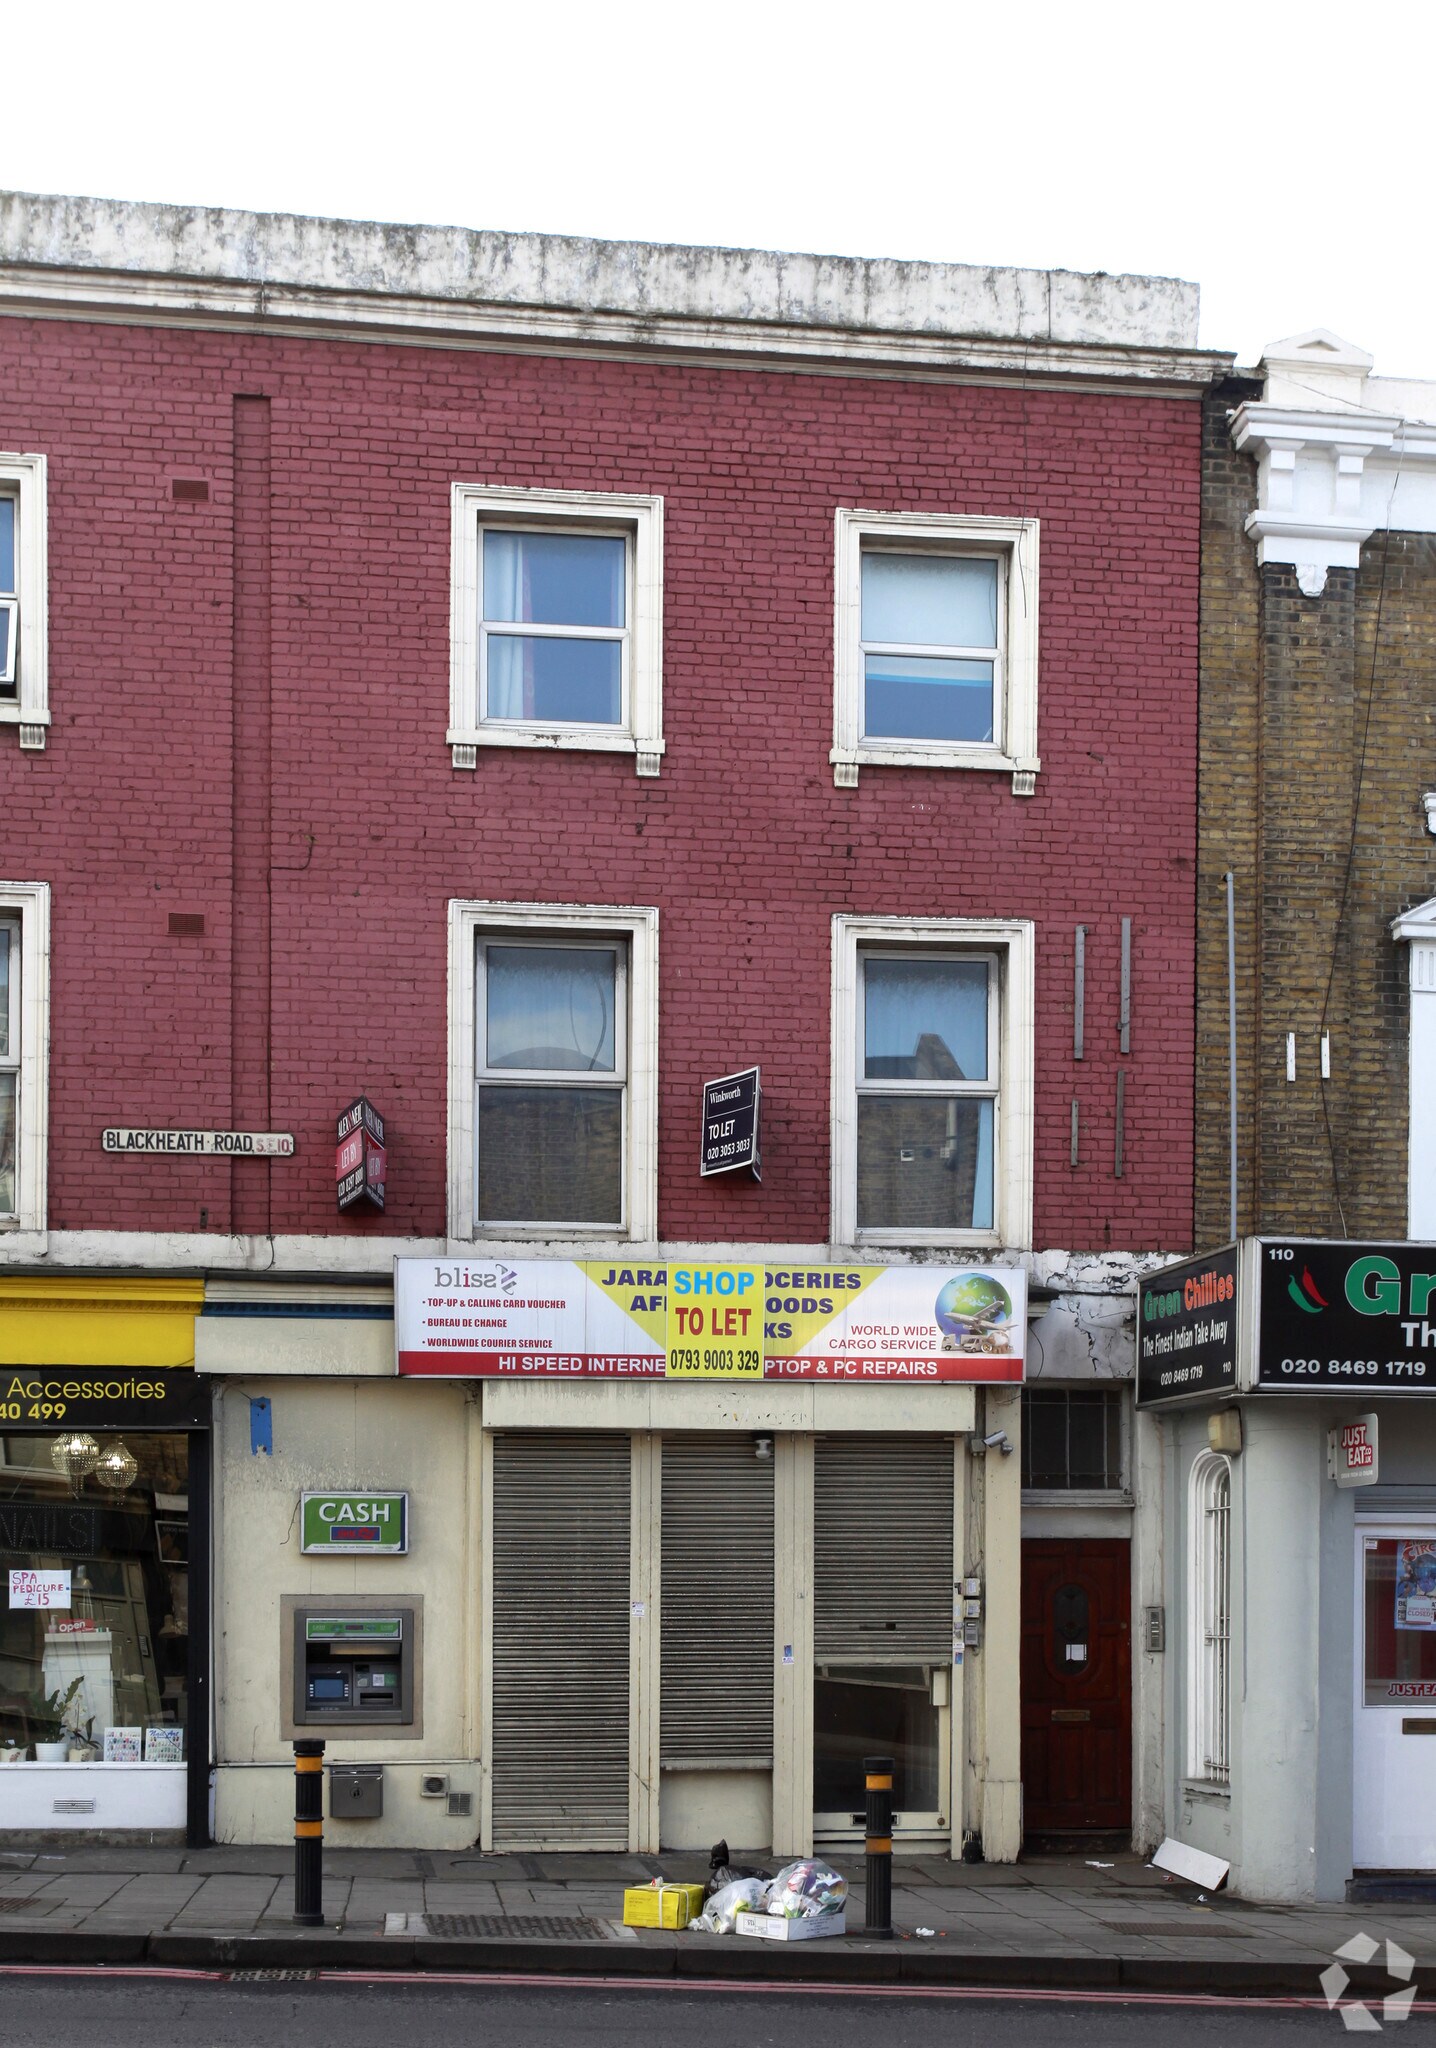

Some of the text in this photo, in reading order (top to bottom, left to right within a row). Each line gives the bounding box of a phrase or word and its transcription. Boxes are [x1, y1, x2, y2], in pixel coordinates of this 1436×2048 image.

[710, 1086, 741, 1104] Winkworth
[708, 1119, 735, 1140] TO LET
[106, 1131, 204, 1150] BLACKHEATH
[707, 1138, 750, 1160] 020 3053 3033
[341, 1147, 350, 1169] LET
[1269, 1249, 1294, 1261] 110
[674, 1270, 755, 1295] SHOP
[427, 1298, 458, 1307] TOP-UP
[468, 1298, 501, 1308] CALLING
[503, 1299, 525, 1308] CARD
[527, 1299, 566, 1309] VOUCHER
[630, 1295, 667, 1312] AF
[1144, 1271, 1234, 1322] Green Chillies
[427, 1318, 507, 1328] BUREAU DE CHANGE
[675, 1307, 752, 1336] TO LET
[851, 1325, 937, 1336] WORLD WIDE
[427, 1338, 553, 1348] WORLDWIDE COURIER SERVICE
[829, 1338, 937, 1350] CARGO SERVICE
[1143, 1319, 1228, 1357] The Finest Indian Take Away
[498, 1356, 516, 1370] HI
[522, 1356, 583, 1371] SPEED
[816, 1360, 828, 1374] &
[833, 1361, 857, 1374] PC
[862, 1361, 938, 1375] REPAIRS
[670, 1348, 759, 1371] 0793 9003 329
[1281, 1358, 1426, 1376] 020 8469 1719
[1161, 1361, 1231, 1386] 020 8469 1719 110
[6, 1377, 166, 1399] Accessories
[28, 1403, 66, 1419] 499
[1342, 1426, 1366, 1447] JUST
[1348, 1446, 1366, 1466] EAT
[319, 1502, 390, 1522] CASH
[0, 1512, 88, 1548] NAILS
[12, 1571, 38, 1585] SPA
[13, 1583, 64, 1594] PEDICURE
[24, 1593, 50, 1606] £15
[59, 1621, 86, 1633] Open
[1389, 1684, 1420, 1696] JUST
